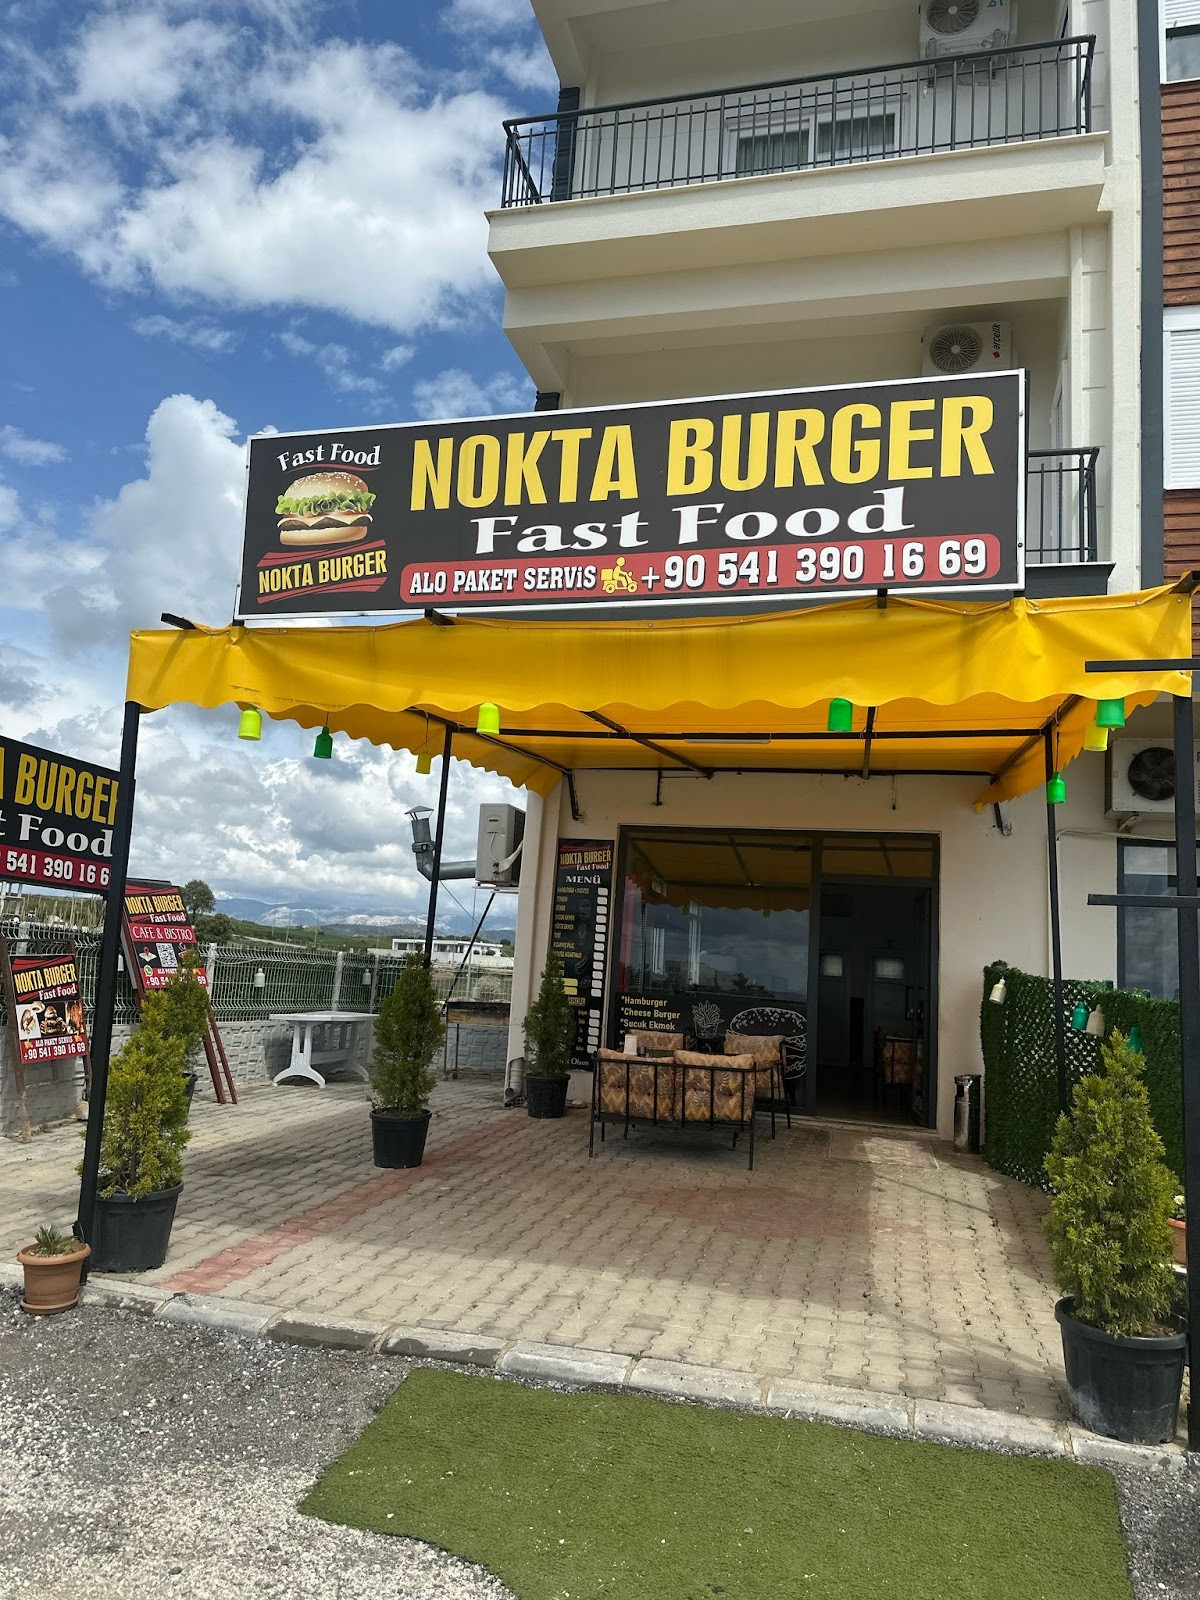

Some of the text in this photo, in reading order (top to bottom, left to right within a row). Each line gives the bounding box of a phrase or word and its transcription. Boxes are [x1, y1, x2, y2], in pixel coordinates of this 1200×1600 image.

[276, 443, 382, 472] Fast Food
[410, 395, 995, 511] NOKTA BURGER
[470, 486, 914, 555] Fast Food
[258, 550, 387, 594] NOKTA BURGER
[409, 571, 447, 595] ALO
[452, 568, 518, 593] PAKET
[641, 554, 706, 591] +90
[717, 550, 778, 587] 541
[795, 544, 865, 583] 390
[882, 541, 925, 579] 16
[938, 538, 987, 577] 69
[18, 813, 113, 858] Food
[560, 849, 612, 866] NOKTA BURGER
[576, 862, 610, 871] Fast Food
[6, 850, 36, 875] 541
[43, 857, 73, 880] 390
[79, 863, 97, 884] 16
[565, 875, 601, 884] MENÜ
[124, 894, 185, 915] NOKTA BURGER
[149, 912, 187, 923] Fast Food
[132, 926, 193, 940] CAFE & BISTRO
[14, 963, 77, 994] NOKTA BURGER
[38, 983, 77, 1001] Fast Food
[624, 996, 668, 1008] Hamburger
[624, 1007, 681, 1020] Cheese Burger
[623, 1019, 675, 1030] Sucuk Ekmek
[38, 1046, 52, 1058] 541
[53, 1044, 67, 1056] 390
[68, 1043, 76, 1054] 16
[77, 1042, 86, 1052] 69
